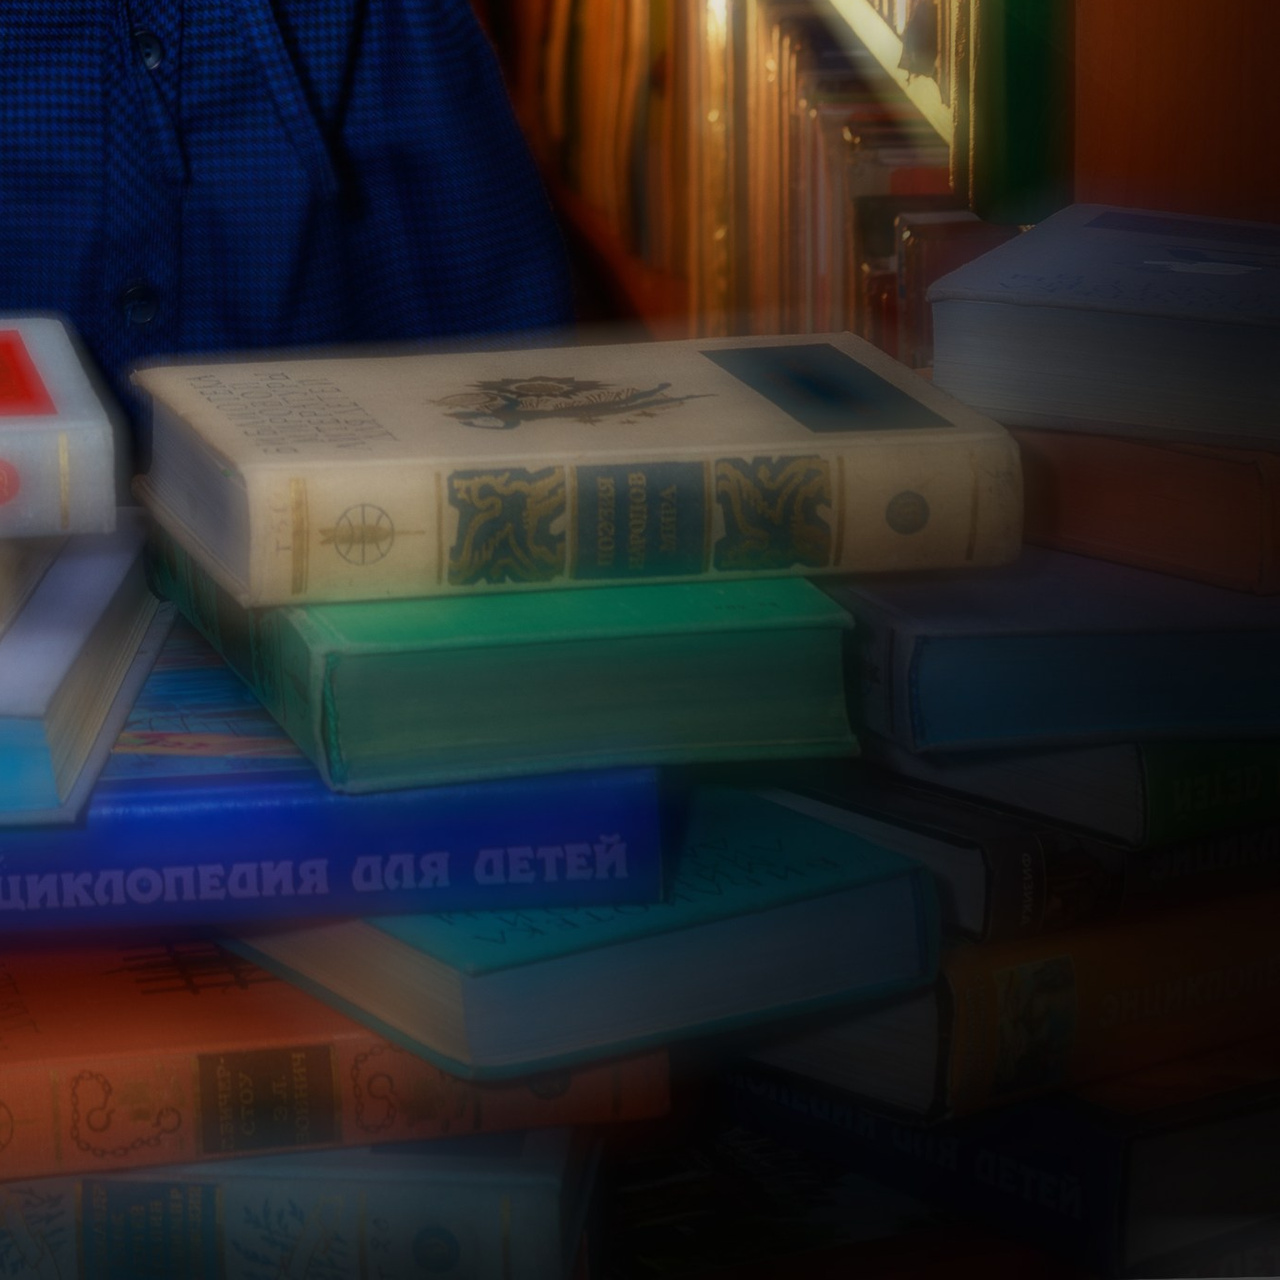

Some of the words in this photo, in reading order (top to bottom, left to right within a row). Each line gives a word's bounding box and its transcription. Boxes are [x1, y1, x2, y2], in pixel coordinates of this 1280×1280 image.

[596, 476, 616, 567] ПОЭЗИЯ
[627, 470, 648, 570] НАРОДОВ
[659, 484, 677, 553] МИРА
[352, 850, 450, 893] ДЛЯ
[473, 834, 629, 888] ДЕТЕЙ
